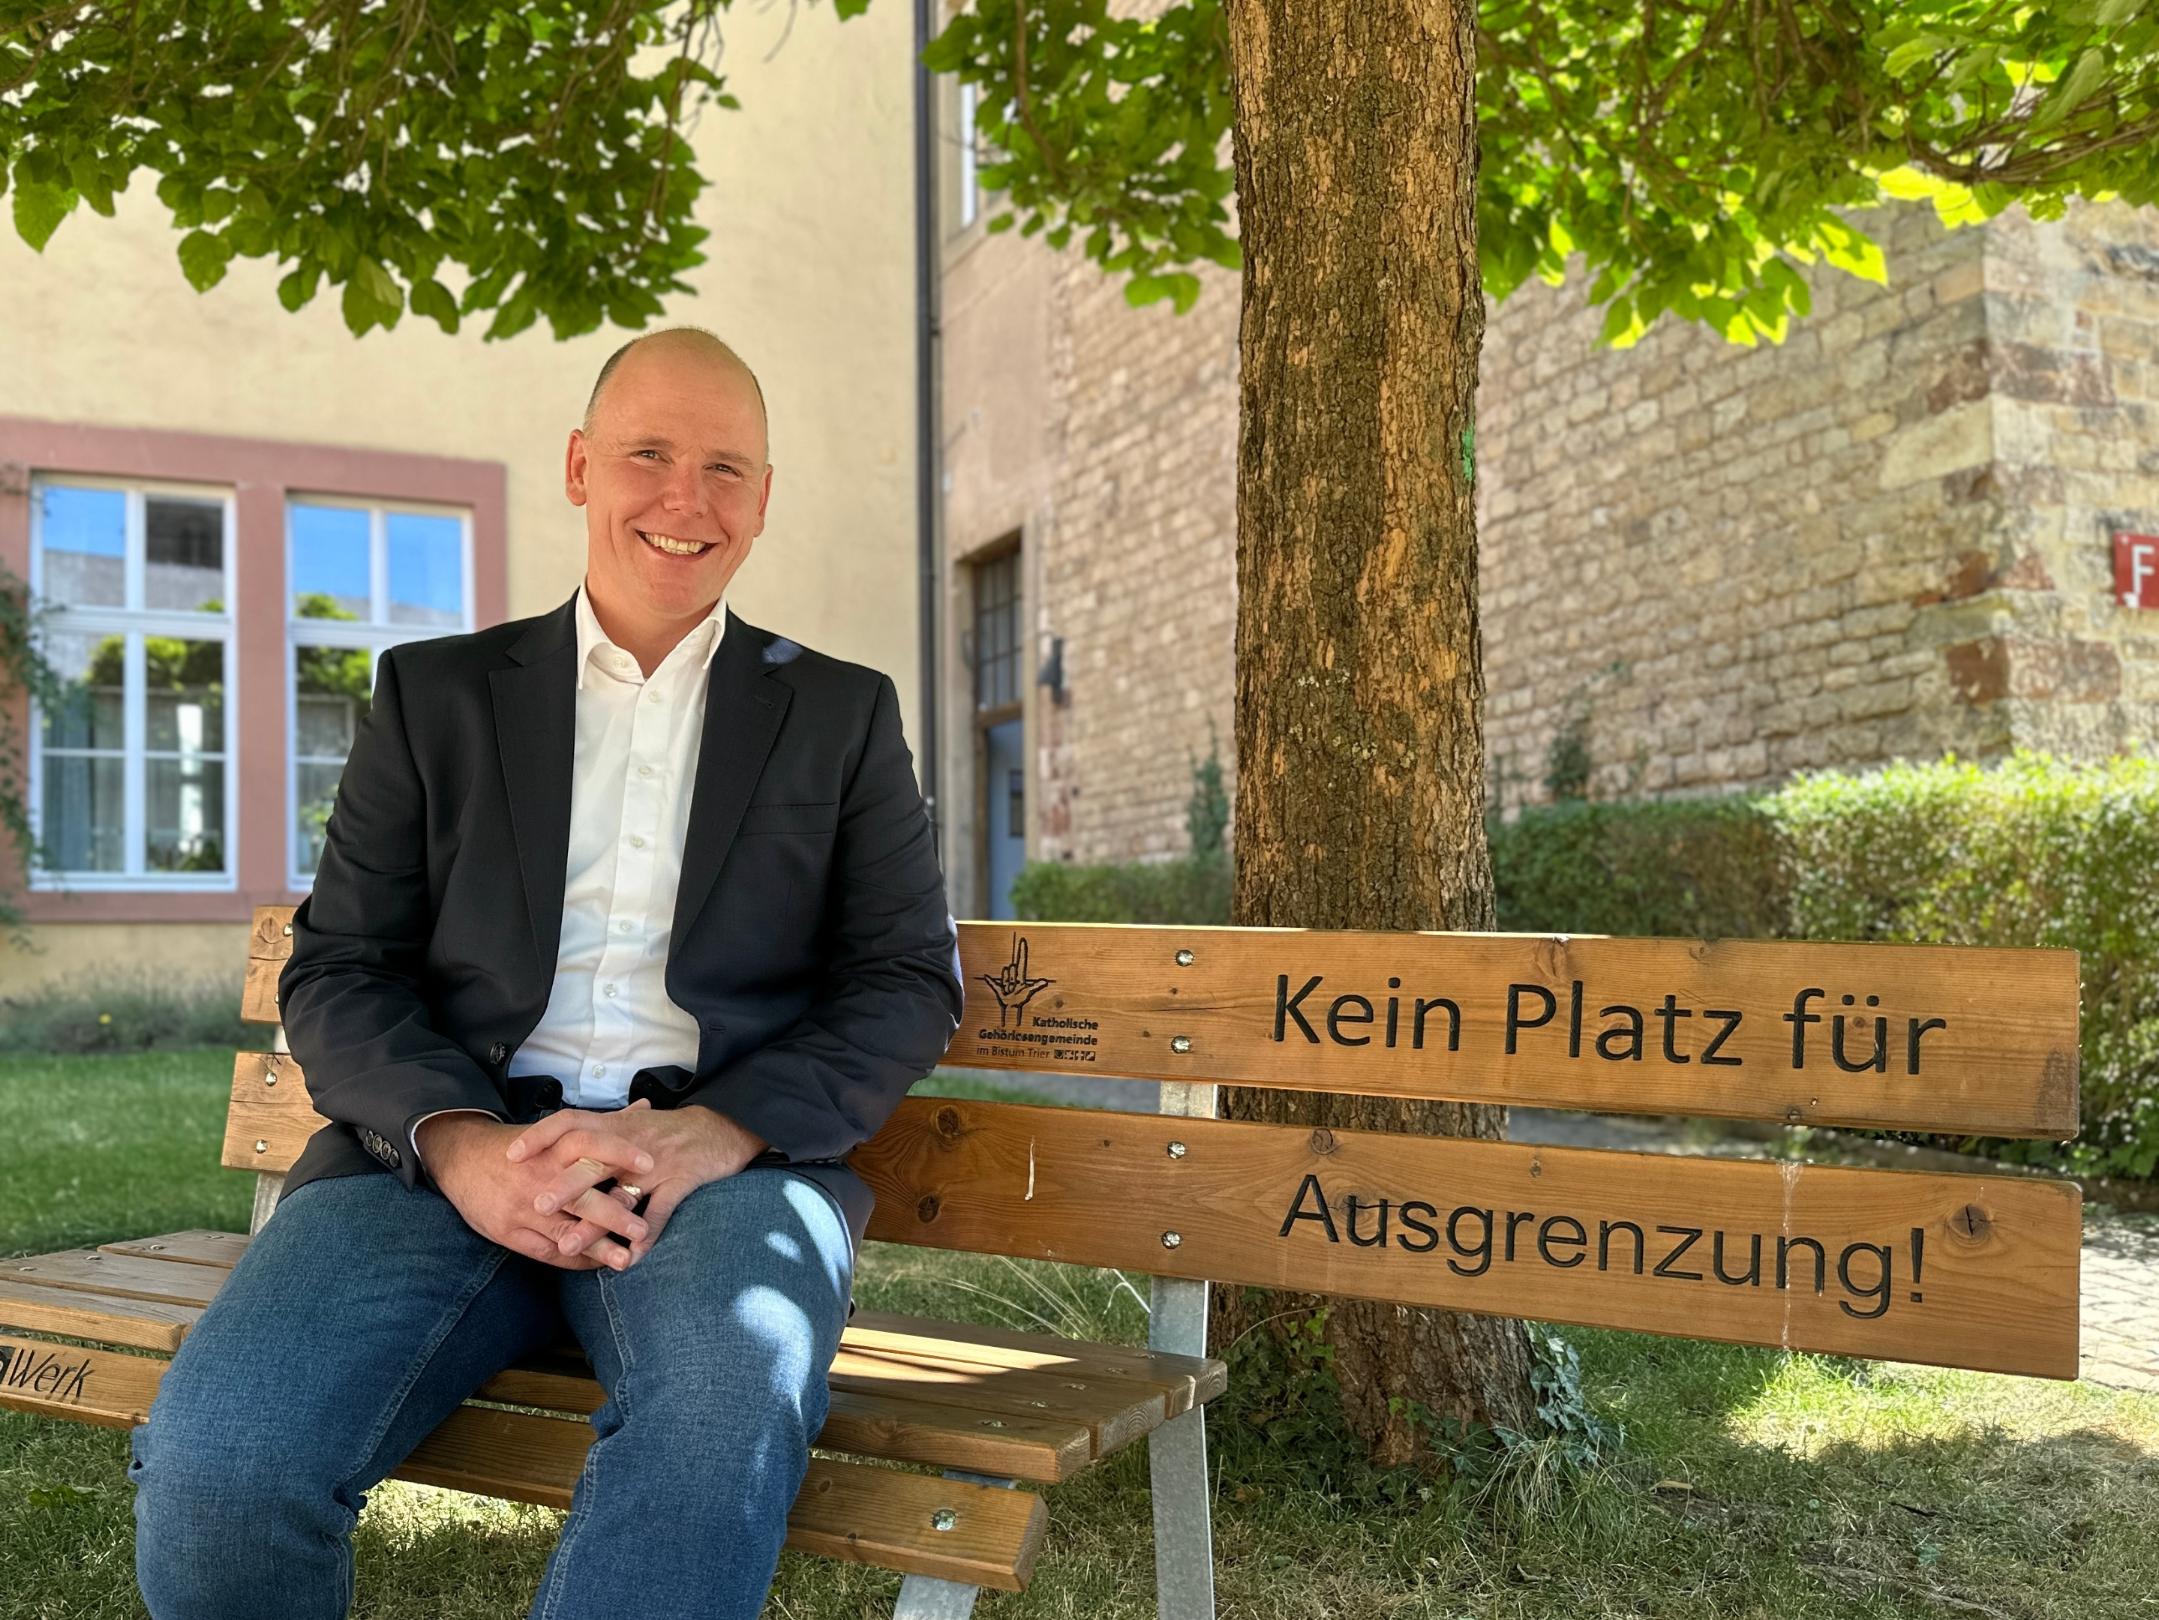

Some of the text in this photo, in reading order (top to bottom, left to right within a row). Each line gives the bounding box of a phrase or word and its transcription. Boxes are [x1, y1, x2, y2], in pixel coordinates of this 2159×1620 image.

[978, 1028, 1098, 1045] Gehörlosengemeinde
[1032, 1016, 1099, 1030] Katholische
[1273, 974, 1947, 1075] Kein Platz für
[976, 1046, 1050, 1059] im Bistum Trier
[1278, 1174, 1925, 1320] Ausgrenzung!
[8, 1348, 95, 1403] Werk
